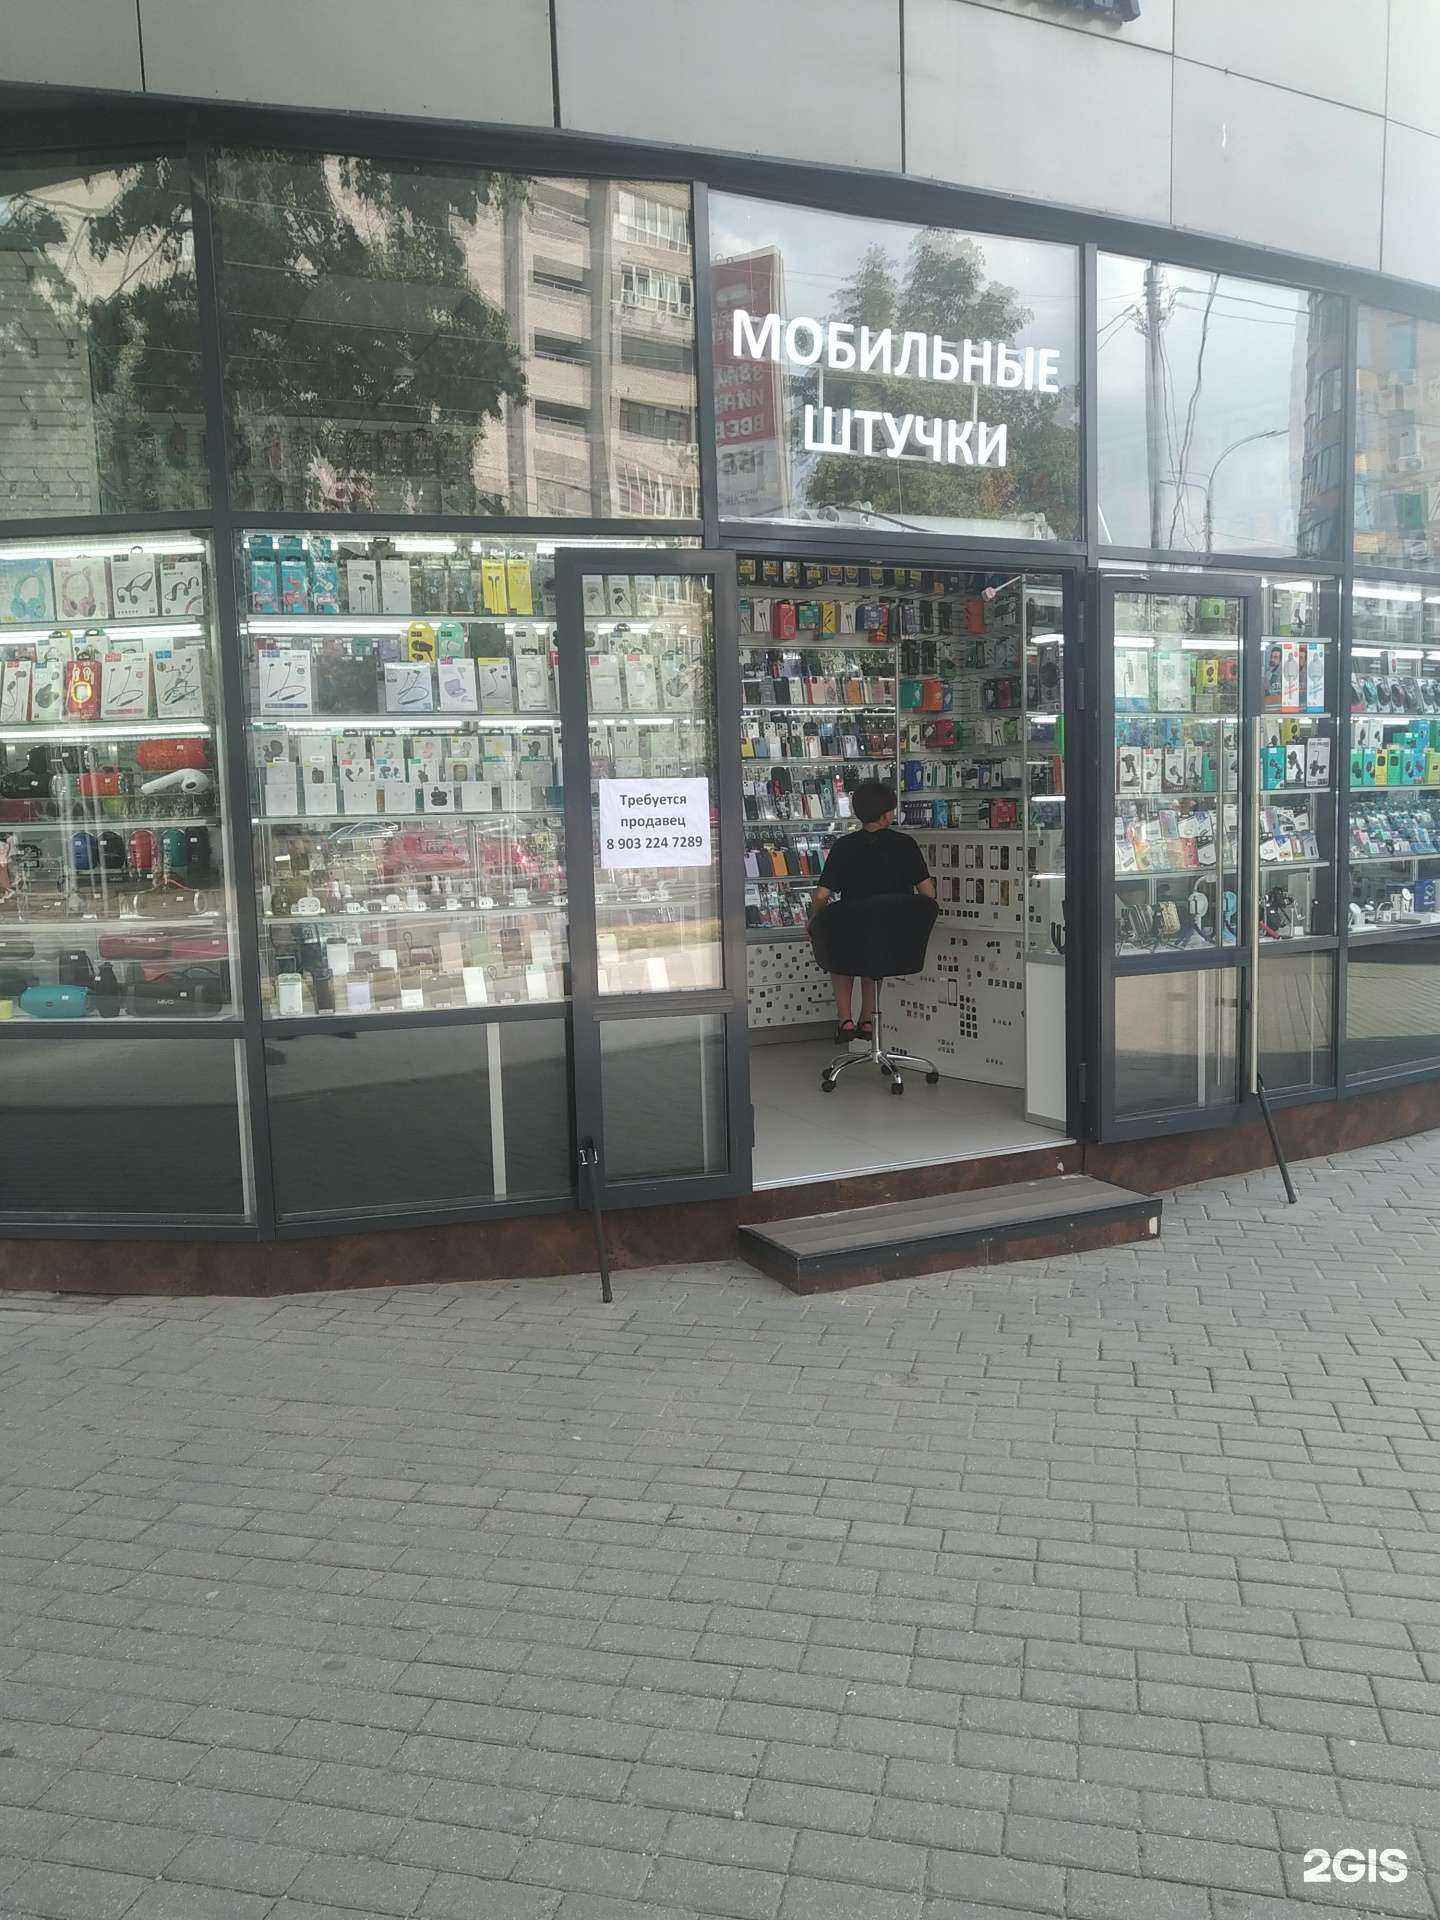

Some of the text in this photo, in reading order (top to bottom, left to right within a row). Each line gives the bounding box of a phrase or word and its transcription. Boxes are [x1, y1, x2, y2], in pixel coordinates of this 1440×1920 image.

[733, 309, 1061, 393] МОБИЛЬНЫЕ
[804, 404, 1008, 468] ШТУЧКИ
[619, 793, 687, 808] Требуется
[620, 817, 687, 829] продавец
[606, 835, 703, 850] 8 903 224 7289
